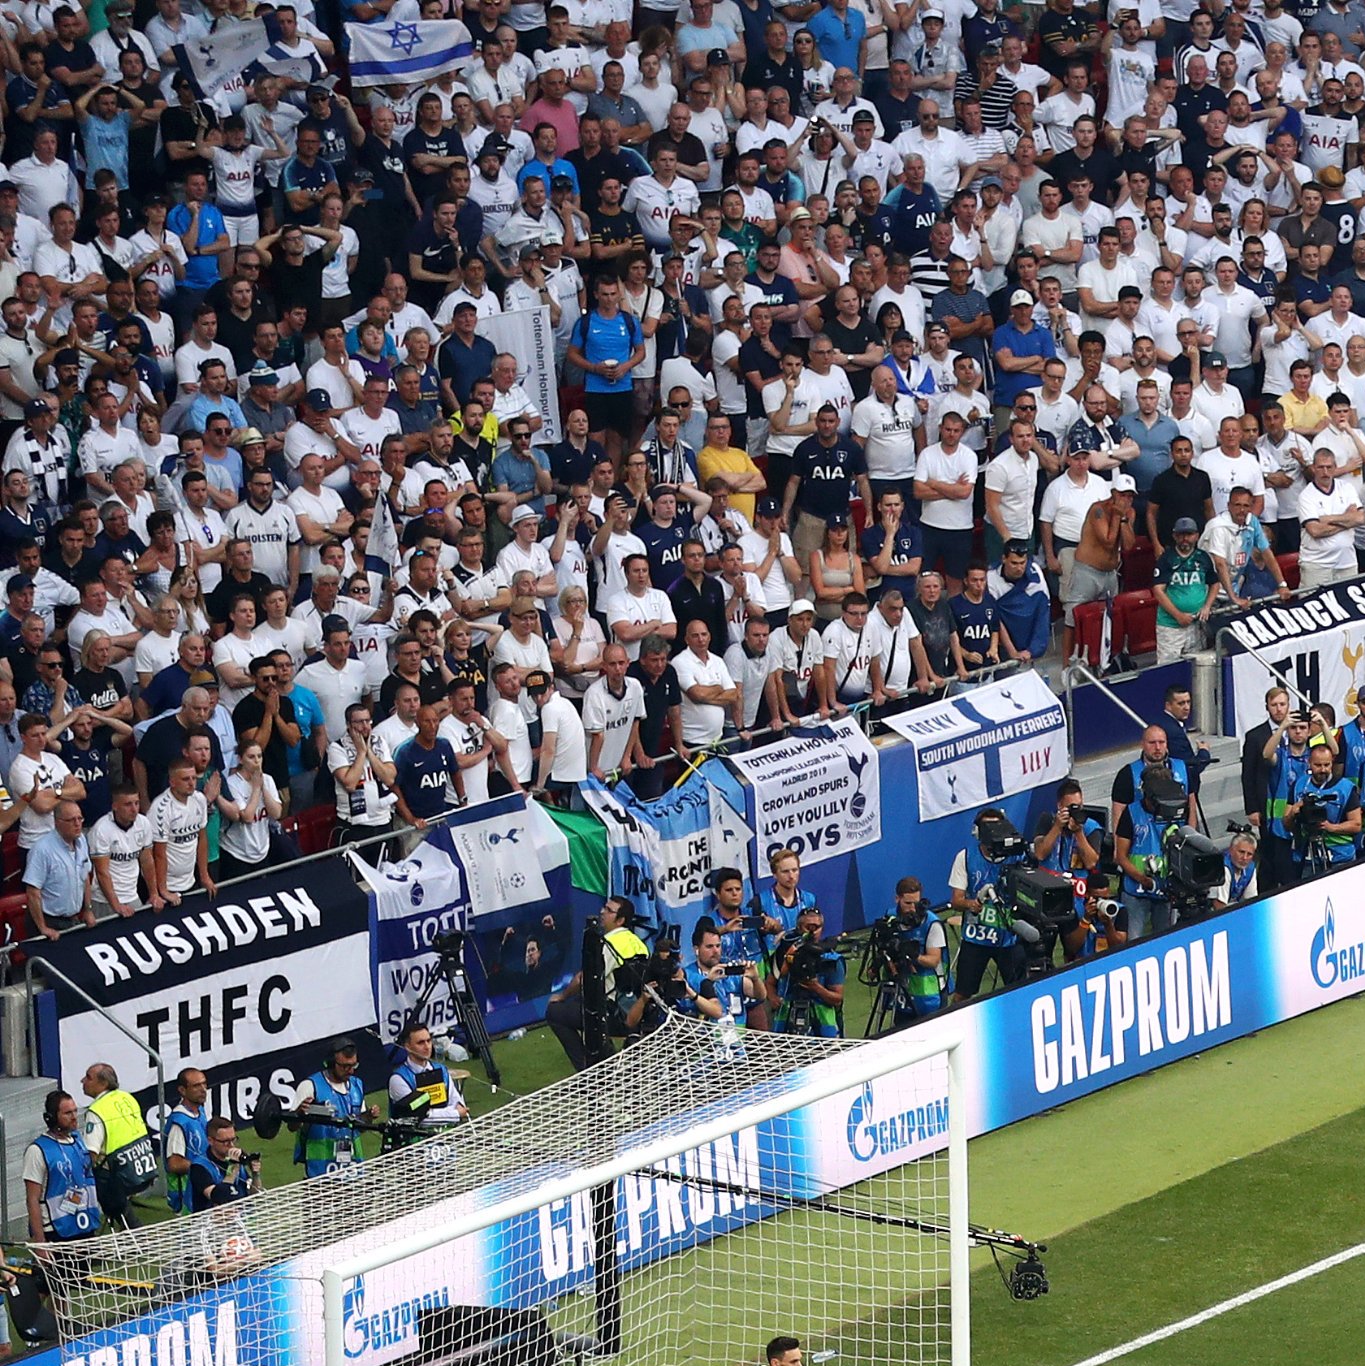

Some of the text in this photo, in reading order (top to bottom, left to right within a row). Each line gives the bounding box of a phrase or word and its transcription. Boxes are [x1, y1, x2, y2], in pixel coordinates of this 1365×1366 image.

[1309, 133, 1340, 149] AIA
[651, 206, 681, 220] AIA
[1337, 214, 1355, 245] 8
[812, 465, 845, 480] AIA
[1169, 571, 1203, 586] AIA
[964, 624, 991, 640] AIA
[1230, 590, 1351, 648] BALDOCK
[907, 713, 959, 735] ROCKY
[921, 710, 1062, 767] SOUTH WOODHAM FERRERS
[743, 737, 805, 770] TOTTENHAM
[1021, 746, 1052, 775] LILY
[420, 770, 448, 789] AIA
[762, 775, 849, 812] CROWLAND SPURS
[764, 797, 849, 837] LOVE YOU LILY
[688, 836, 708, 857] THE
[84, 887, 321, 987] RUSHDEN
[965, 923, 999, 944] 034
[136, 974, 293, 1069] THFC
[1030, 929, 1233, 1095] GAZPROM
[878, 1095, 950, 1157] GAZPROM
